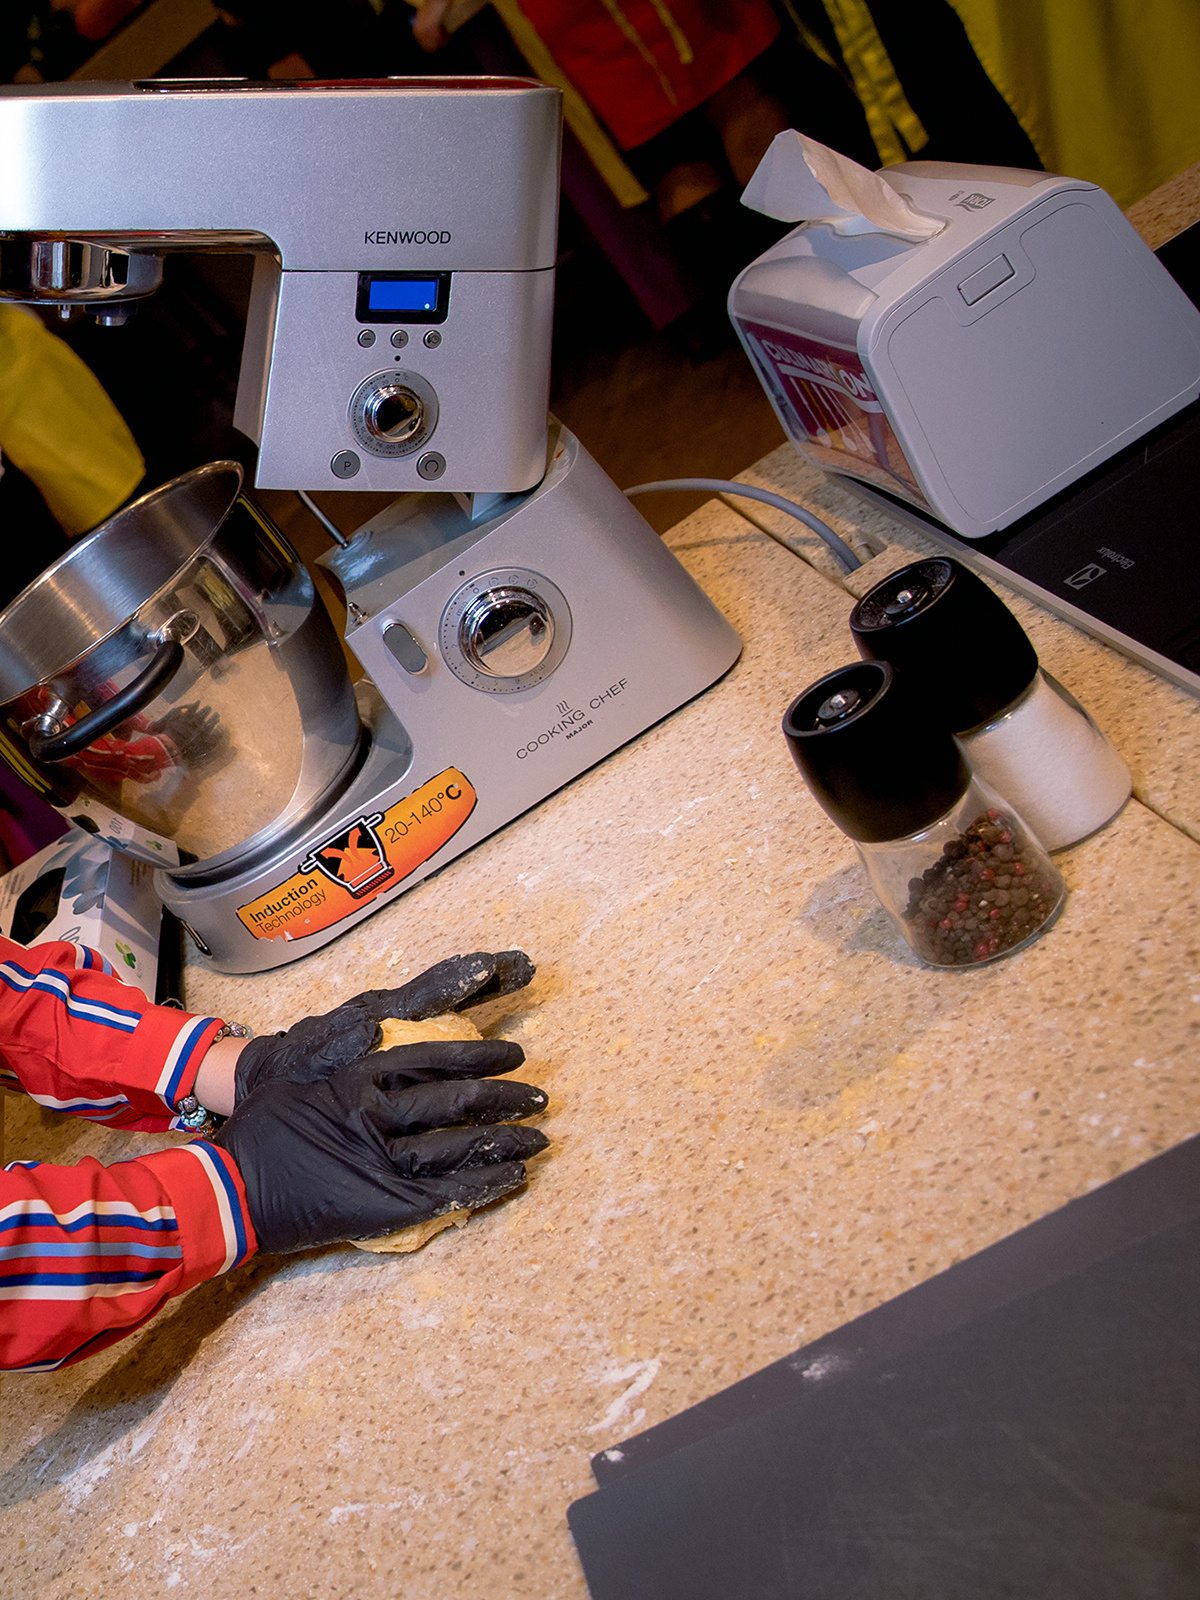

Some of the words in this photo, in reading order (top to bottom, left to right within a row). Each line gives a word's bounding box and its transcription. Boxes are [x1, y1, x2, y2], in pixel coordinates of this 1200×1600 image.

[364, 231, 451, 245] KENWOOD
[344, 461, 351, 471] P
[1097, 547, 1135, 569] Electrolux
[516, 709, 586, 759] COOKING
[589, 677, 628, 710] CHEF
[565, 719, 594, 740] MAJOR
[384, 783, 462, 844] 20-140°C
[249, 877, 318, 923] Induction
[256, 888, 327, 934] Technology
